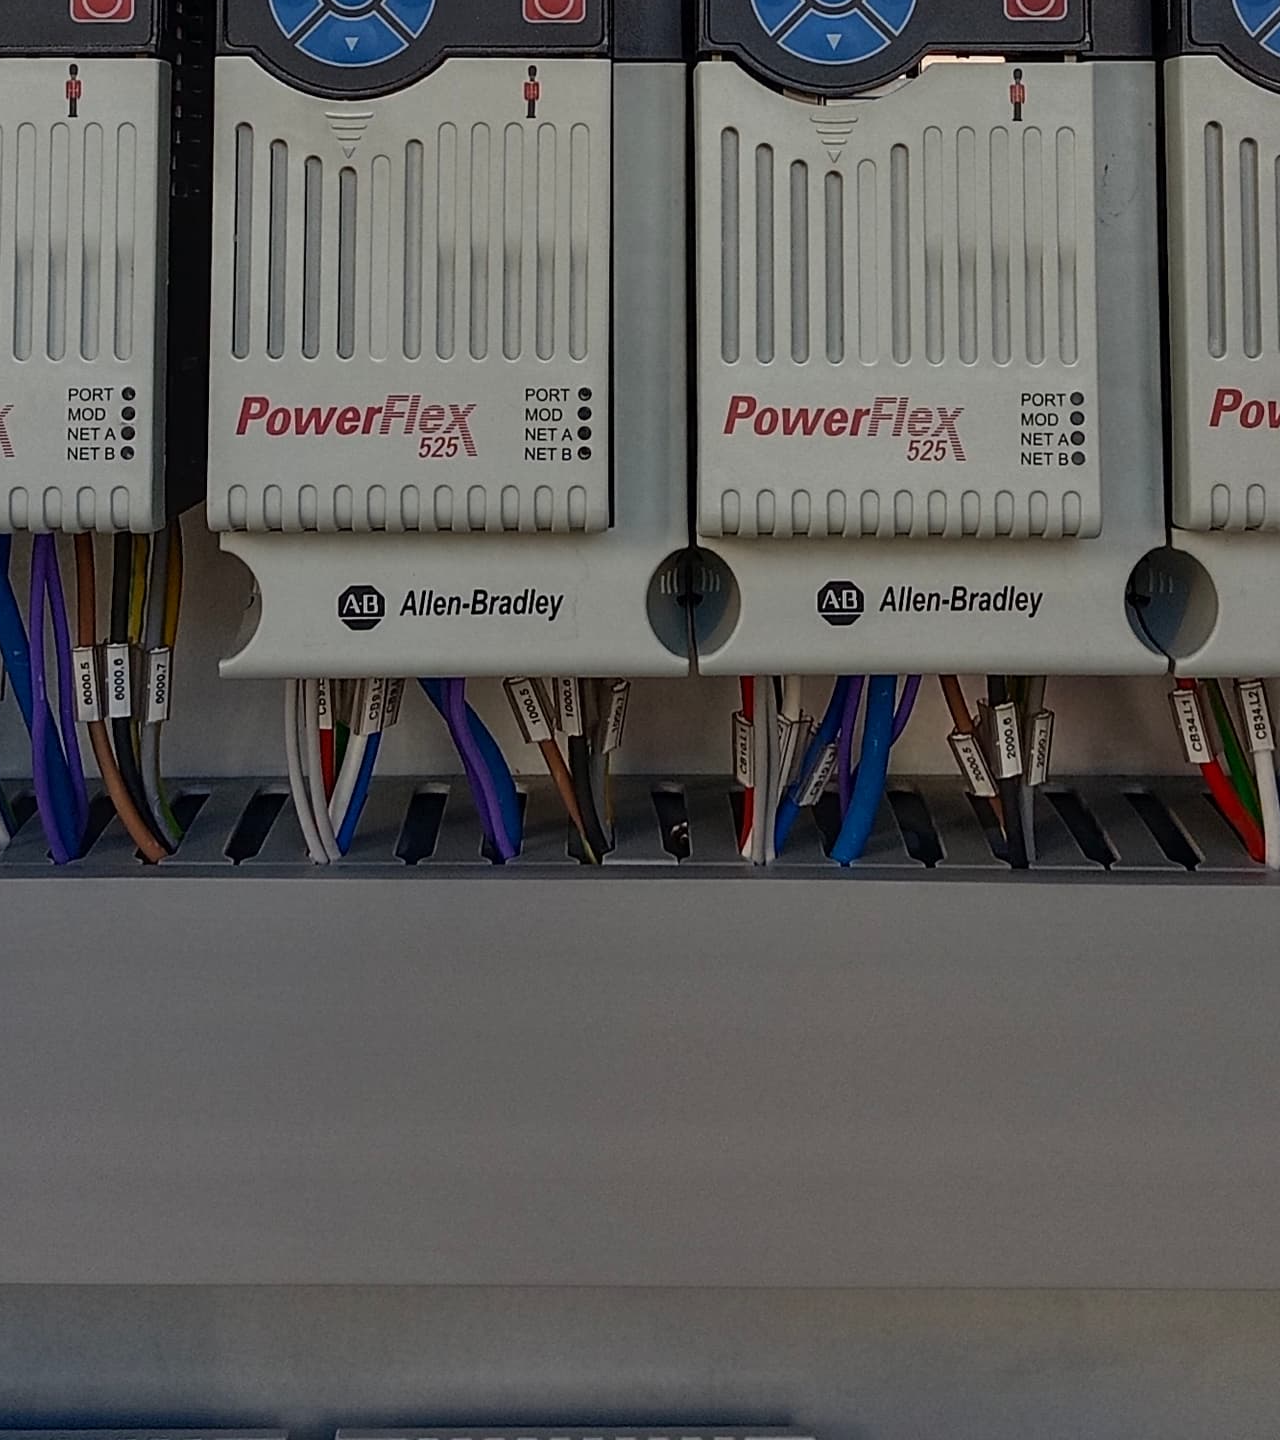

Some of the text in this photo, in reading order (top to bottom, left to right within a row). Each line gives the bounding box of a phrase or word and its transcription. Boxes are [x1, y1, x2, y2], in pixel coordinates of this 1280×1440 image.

[67, 388, 114, 402] PORT
[524, 388, 570, 402] PORT
[1020, 392, 1066, 407] PORT
[67, 407, 106, 422] MOD
[525, 407, 563, 422] MOD
[1020, 412, 1060, 427] MOD
[235, 394, 478, 458] PowerFlex
[723, 395, 967, 462] PowerFlex
[66, 427, 116, 441] NET A
[524, 427, 573, 442] NET A
[1020, 432, 1069, 446] NET A
[66, 447, 115, 461] NET B
[418, 436, 459, 459] 525
[524, 447, 572, 461] NET B
[907, 440, 948, 461] 525
[1020, 452, 1069, 466] NET B
[399, 588, 563, 622] Allen-Bradley
[879, 585, 1043, 618] Allen-Bradley
[519, 688, 540, 725] 1000.5
[1248, 690, 1268, 740] CB34.L2
[1182, 699, 1203, 753] CB34.L1
